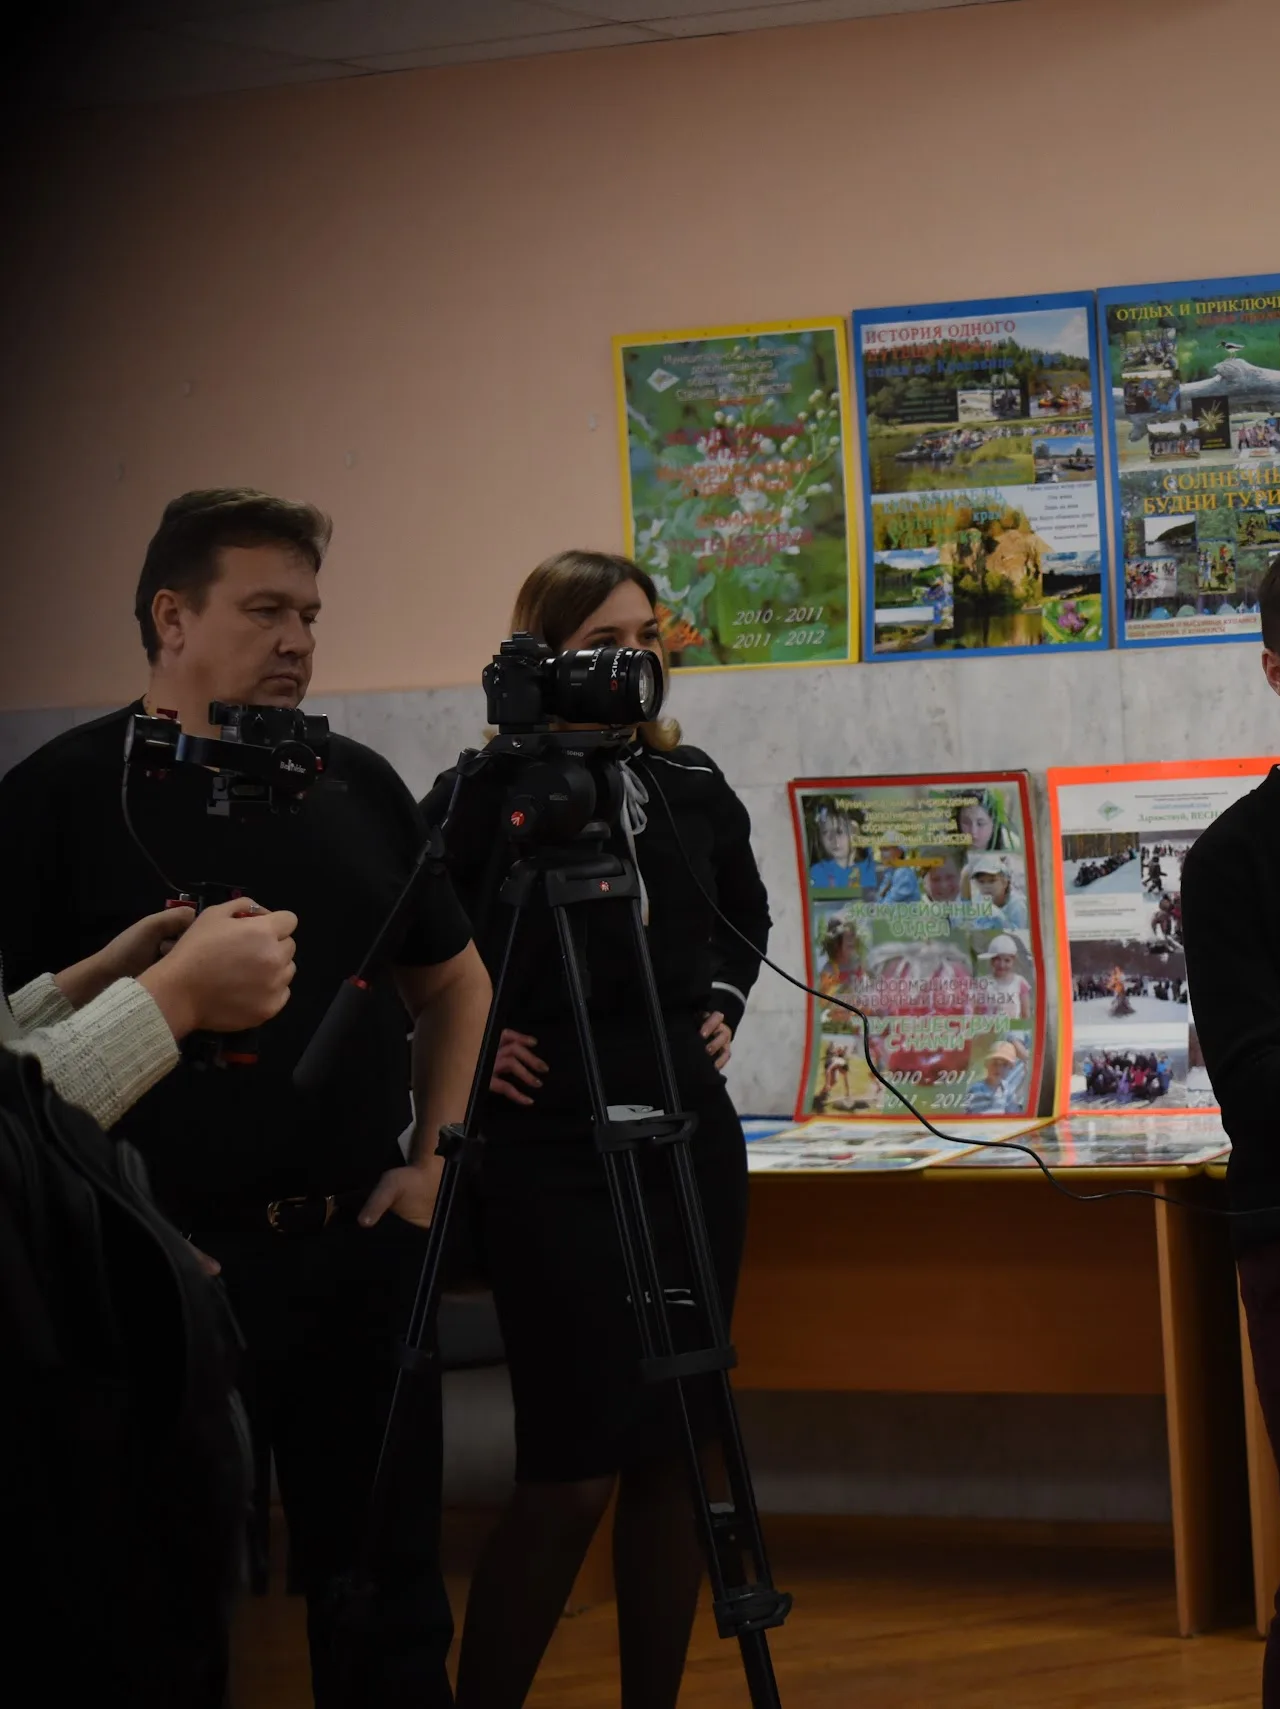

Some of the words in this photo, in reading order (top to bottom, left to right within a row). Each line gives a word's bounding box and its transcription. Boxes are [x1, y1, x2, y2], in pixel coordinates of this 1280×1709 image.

[1115, 304, 1175, 322] ОТДЫХ
[1179, 303, 1191, 317] И
[865, 325, 943, 345] ИСТОРИЯ
[948, 319, 1017, 338] ОДНОГО
[1143, 493, 1218, 515] БУДНИ
[731, 609, 774, 626] 2010
[784, 605, 825, 623] 2011
[730, 633, 771, 650] 2011
[783, 629, 826, 647] 2012
[1191, 808, 1224, 821] ВЕСН
[889, 917, 951, 940] отдел
[854, 1011, 1011, 1038] ПУТЕШЕСТВУЙ
[903, 1030, 967, 1051] НАМИ
[934, 1069, 976, 1086] 2011
[930, 1093, 972, 1108] 2012
